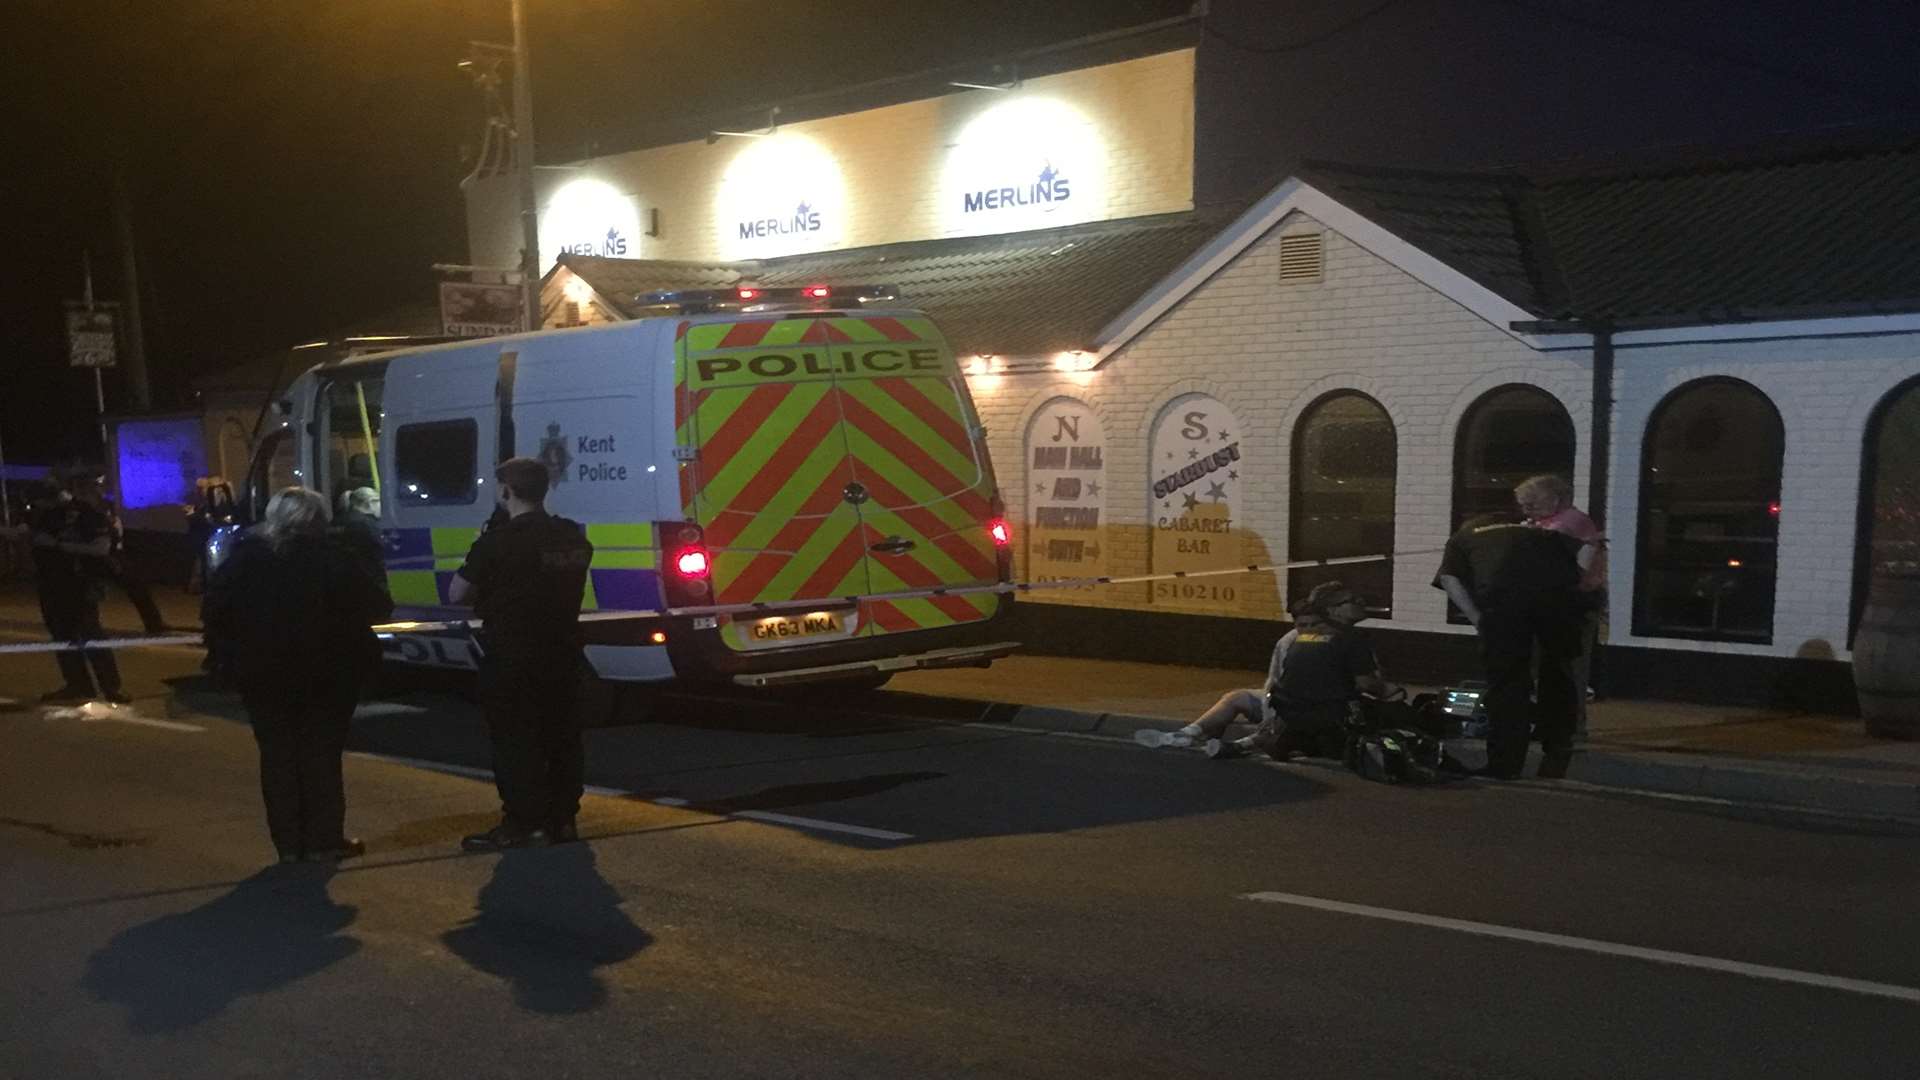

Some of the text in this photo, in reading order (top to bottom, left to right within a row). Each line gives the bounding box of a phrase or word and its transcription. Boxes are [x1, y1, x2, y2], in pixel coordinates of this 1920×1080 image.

[964, 178, 1070, 213] MERLINS
[739, 212, 821, 240] MERLINS
[697, 348, 943, 381] POLICE
[1052, 415, 1080, 442] N
[1181, 411, 1208, 440] S
[578, 434, 616, 453] Kent
[579, 462, 627, 481] Police
[1153, 442, 1241, 499] STARDUST
[1158, 516, 1233, 533] CABARET
[1176, 539, 1211, 554] BAR
[1157, 583, 1235, 601] 510210
[754, 615, 837, 639] GK63 MKA
